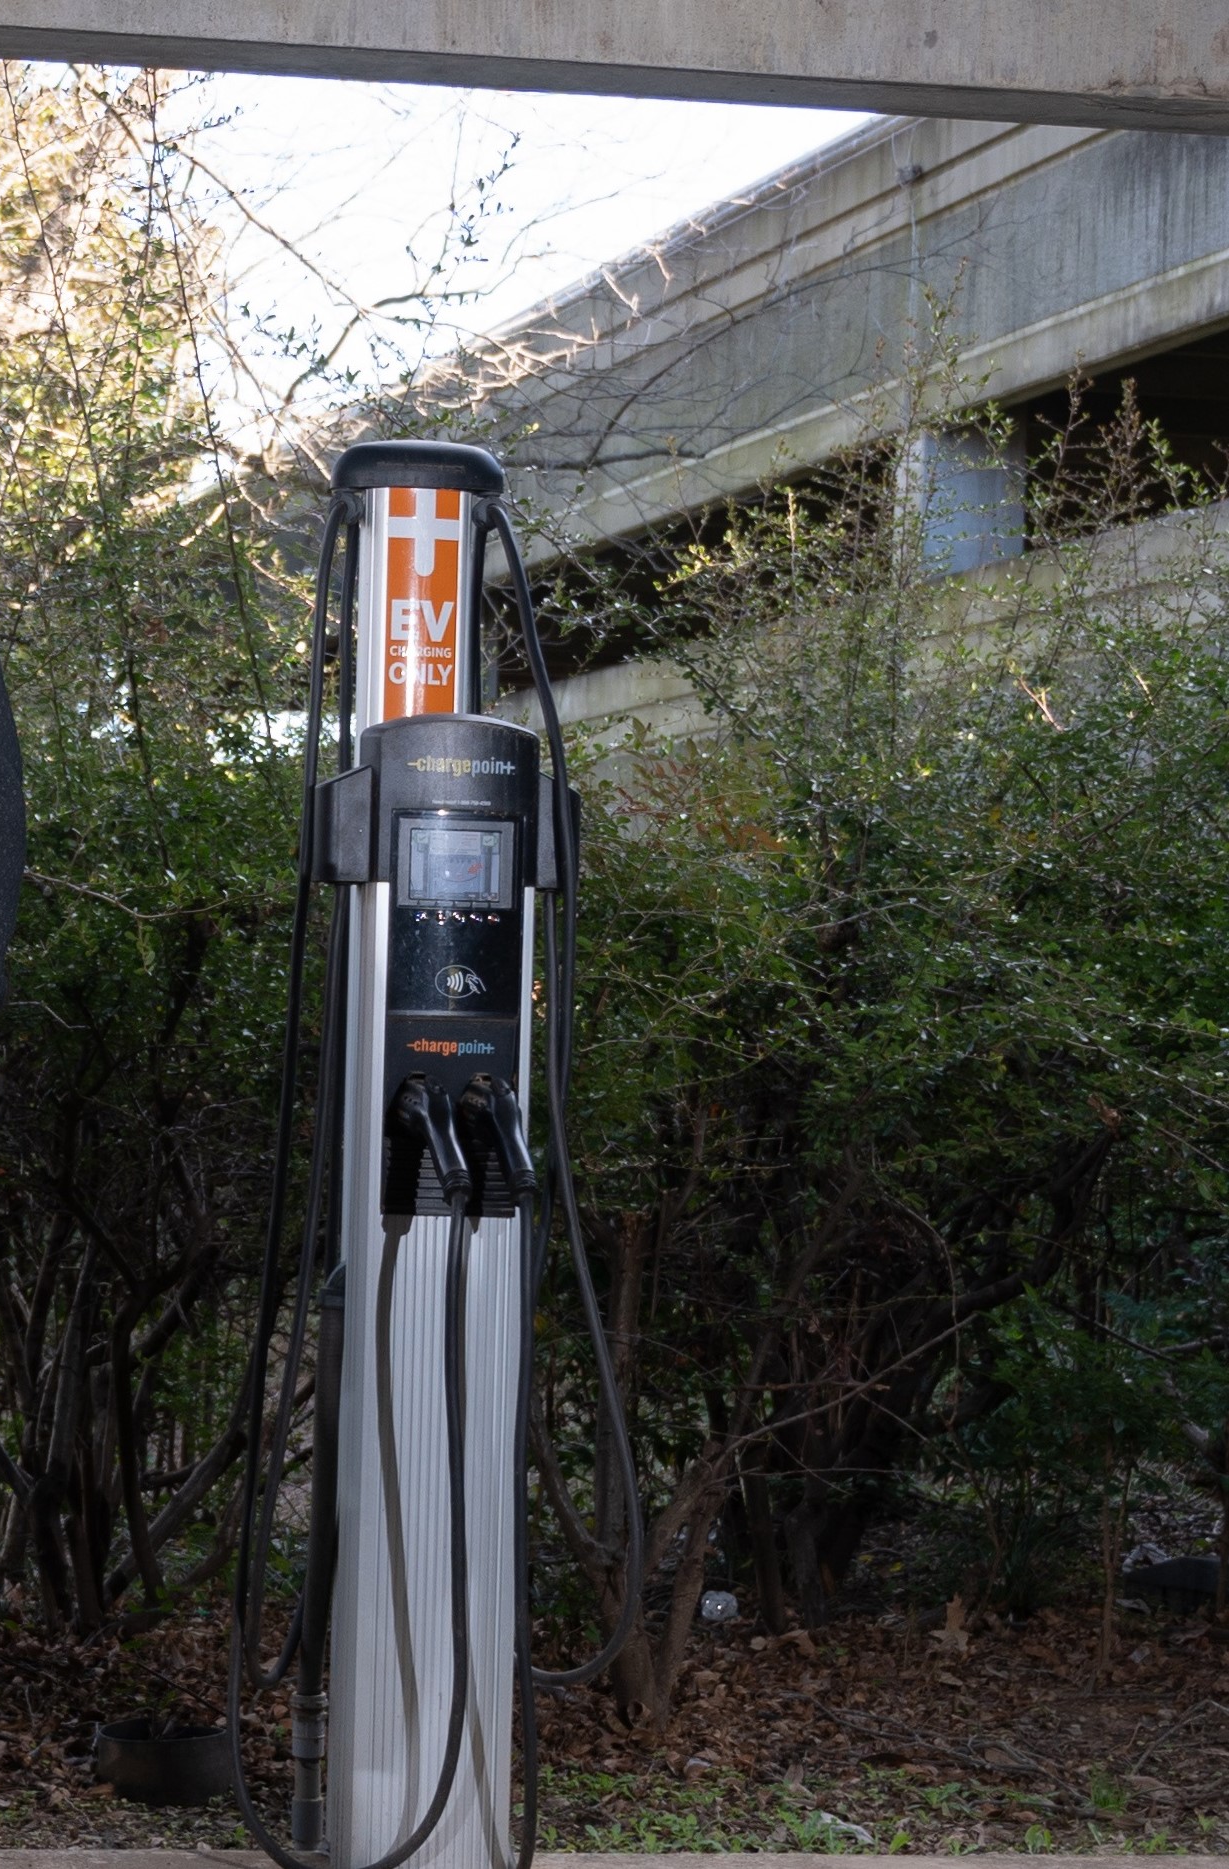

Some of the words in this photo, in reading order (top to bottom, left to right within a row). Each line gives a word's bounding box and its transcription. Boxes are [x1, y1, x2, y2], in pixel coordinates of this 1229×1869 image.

[391, 599, 455, 642] EV
[389, 645, 453, 659] CHRGING
[388, 661, 453, 686] ONLY
